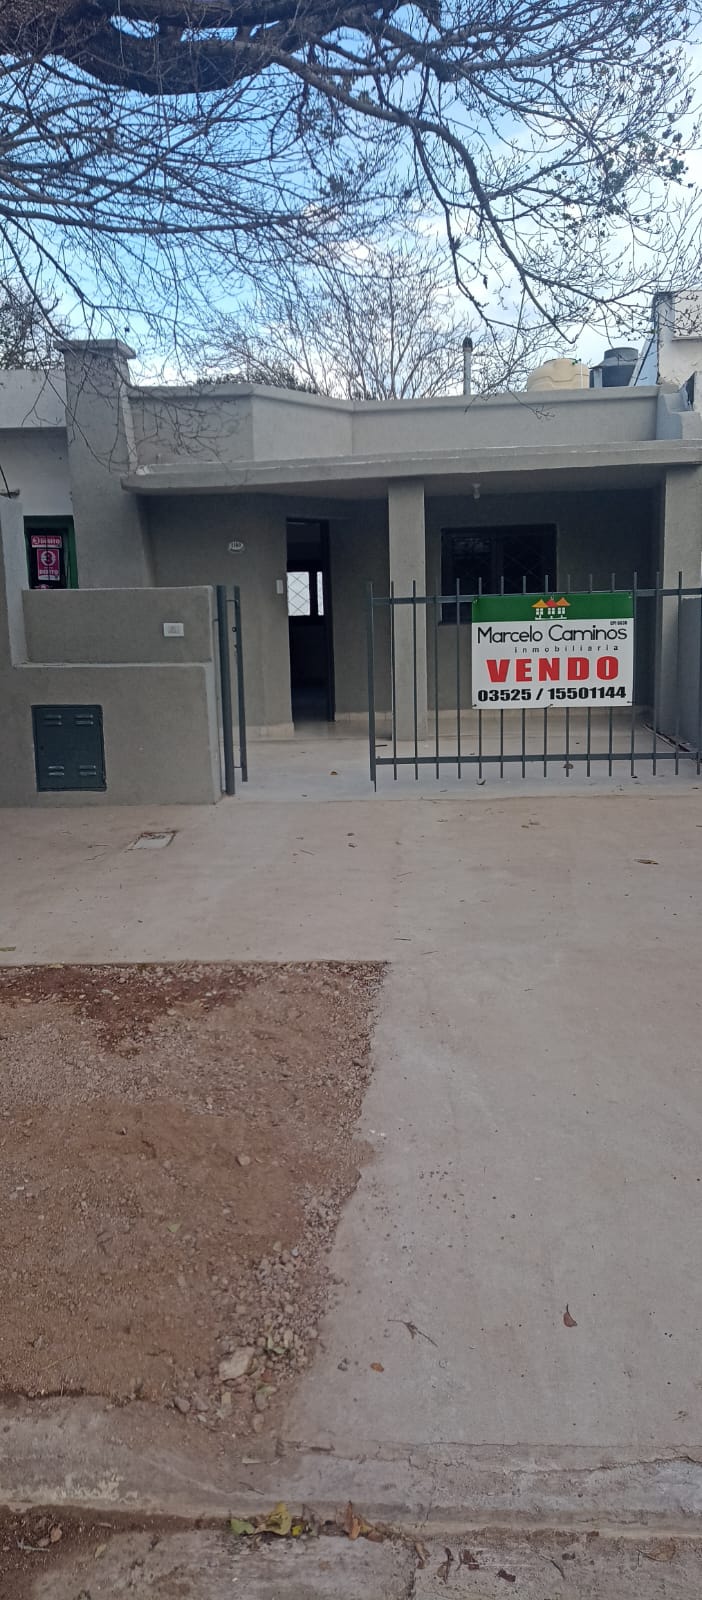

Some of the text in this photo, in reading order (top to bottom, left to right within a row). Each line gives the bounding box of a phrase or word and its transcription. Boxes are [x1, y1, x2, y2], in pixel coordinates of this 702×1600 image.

[477, 624, 628, 643] Marcelo Caminos
[514, 645, 619, 653] inmobiliaria
[486, 656, 619, 683] VENDO
[478, 687, 626, 701] 03525 / 15501144
